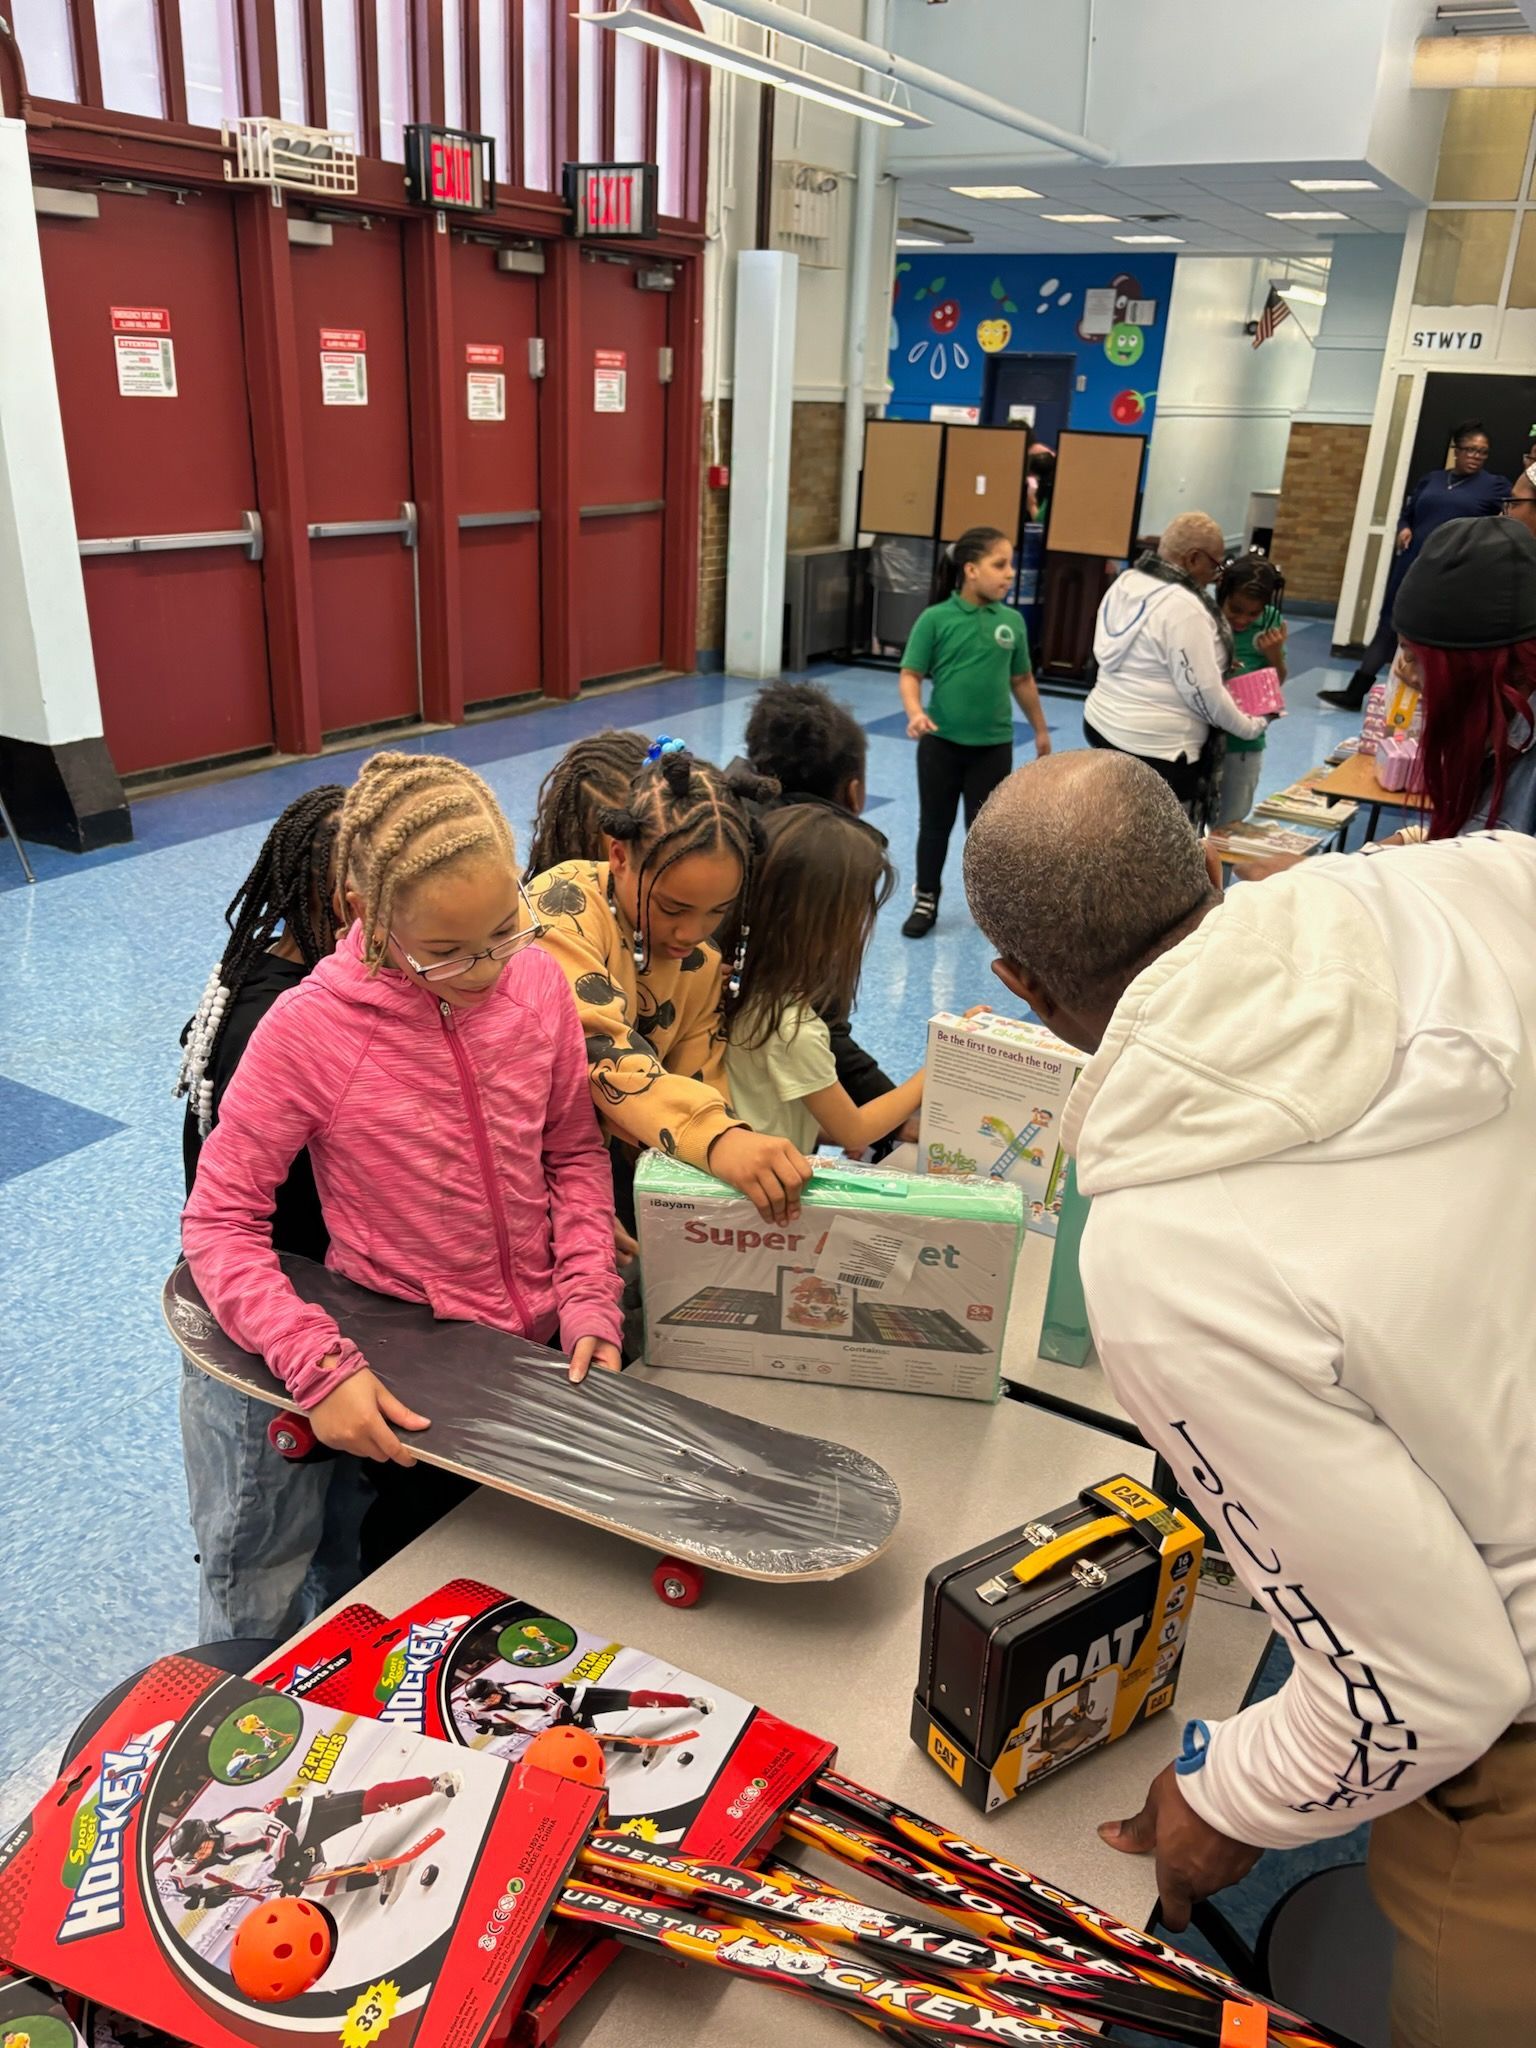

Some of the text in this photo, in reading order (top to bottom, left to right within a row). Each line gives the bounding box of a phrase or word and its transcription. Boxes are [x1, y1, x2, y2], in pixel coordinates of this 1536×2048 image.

[431, 143, 473, 203] EXIT
[587, 176, 634, 225] EXIT
[1412, 332, 1483, 349] STWYD
[937, 1030, 949, 1042] Be
[950, 1034, 965, 1047] the
[966, 1038, 985, 1053] first
[987, 1045, 997, 1055] to
[998, 1048, 1024, 1064] reach
[1025, 1055, 1041, 1068] the
[1043, 1060, 1062, 1074] top!
[928, 1143, 977, 1172] Chutes
[684, 1221, 805, 1253] Super
[917, 1244, 961, 1270] et
[1110, 1485, 1155, 1509] CAT
[1178, 1554, 1189, 1568] 16
[297, 1668, 329, 1692] Sports
[327, 1656, 348, 1673] Fun
[381, 1657, 399, 1689] Sport
[573, 1651, 601, 1677] 2 PLAY
[586, 1652, 616, 1682] MODES
[1044, 1614, 1145, 1701] CAT
[379, 1623, 447, 1734] HOCKEY
[1151, 1691, 1169, 1709] CAT
[298, 1733, 330, 1782] 2 PLAY
[312, 1733, 348, 1784] MODES
[934, 1737, 958, 1770] CAT
[7, 1830, 28, 1855] Fun
[57, 1751, 148, 1945] HOCKEY
[69, 1814, 90, 1866] Sport
[84, 1816, 98, 1855] Set
[522, 1817, 556, 1875] MADE IN CHINA
[591, 1838, 746, 1892] UPERSTAR
[822, 1773, 944, 1837] PERSTAR
[942, 1840, 1205, 1978] HOCKEY
[793, 1805, 1140, 1979] PERSTAR HOCKE
[561, 1888, 723, 1943] UPERSTAR
